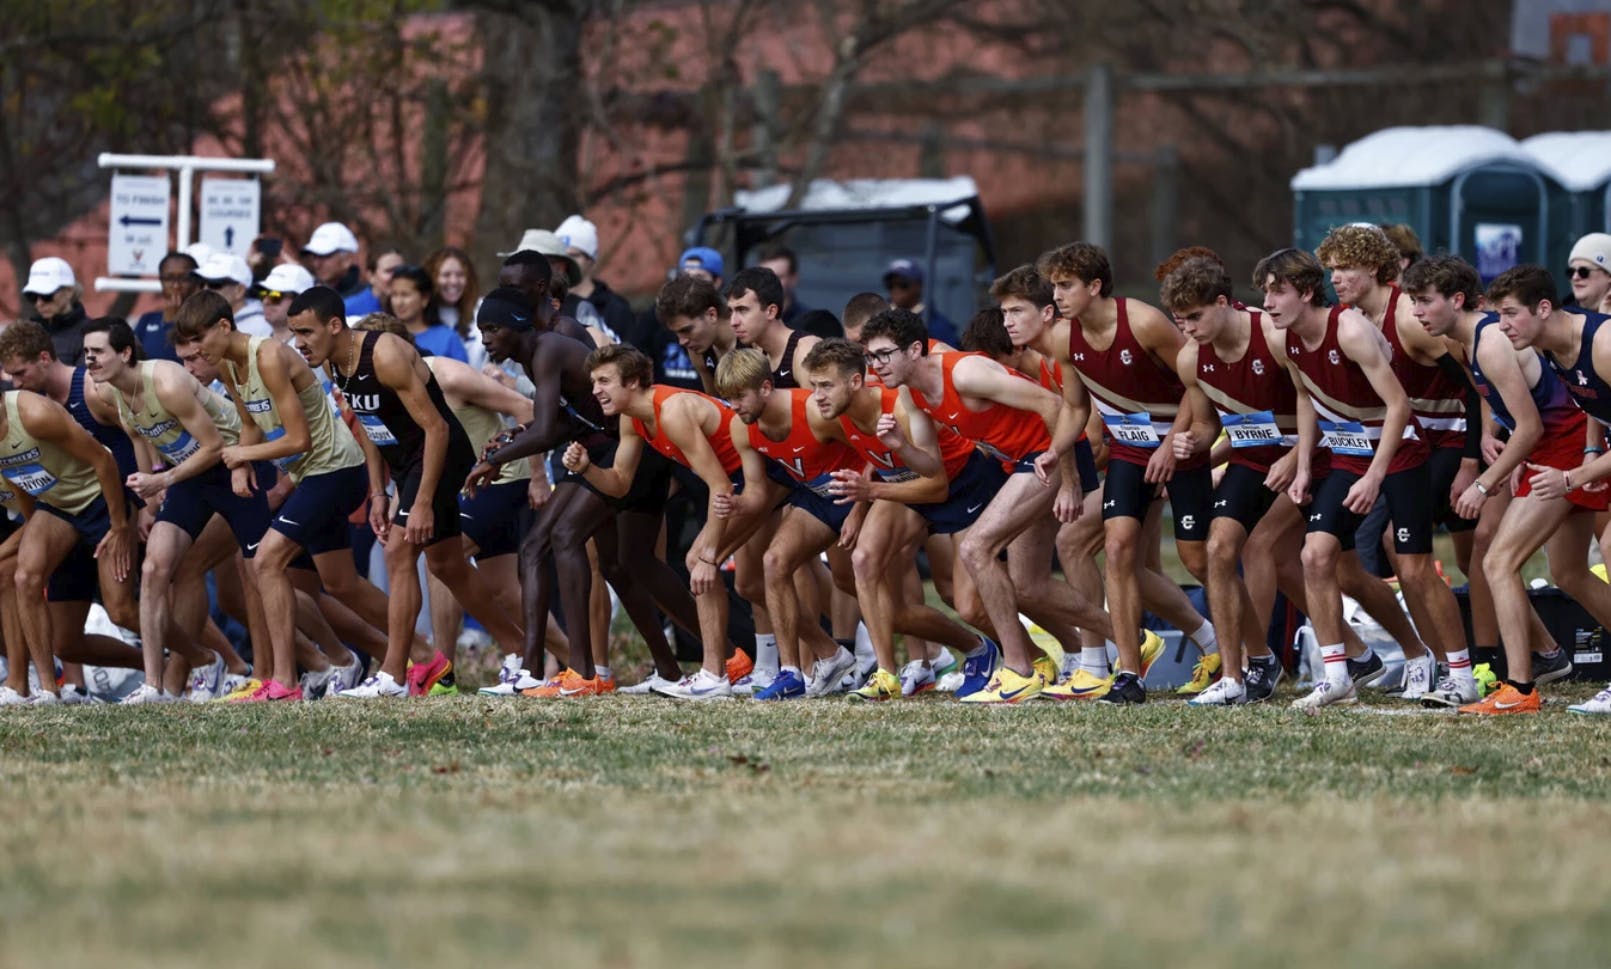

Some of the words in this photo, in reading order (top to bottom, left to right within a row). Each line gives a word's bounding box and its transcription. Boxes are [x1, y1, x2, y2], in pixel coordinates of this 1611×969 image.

[1118, 430, 1150, 442] FLAIG
[1234, 428, 1274, 440] BYRNE
[1327, 436, 1369, 449] BUCKLEY
